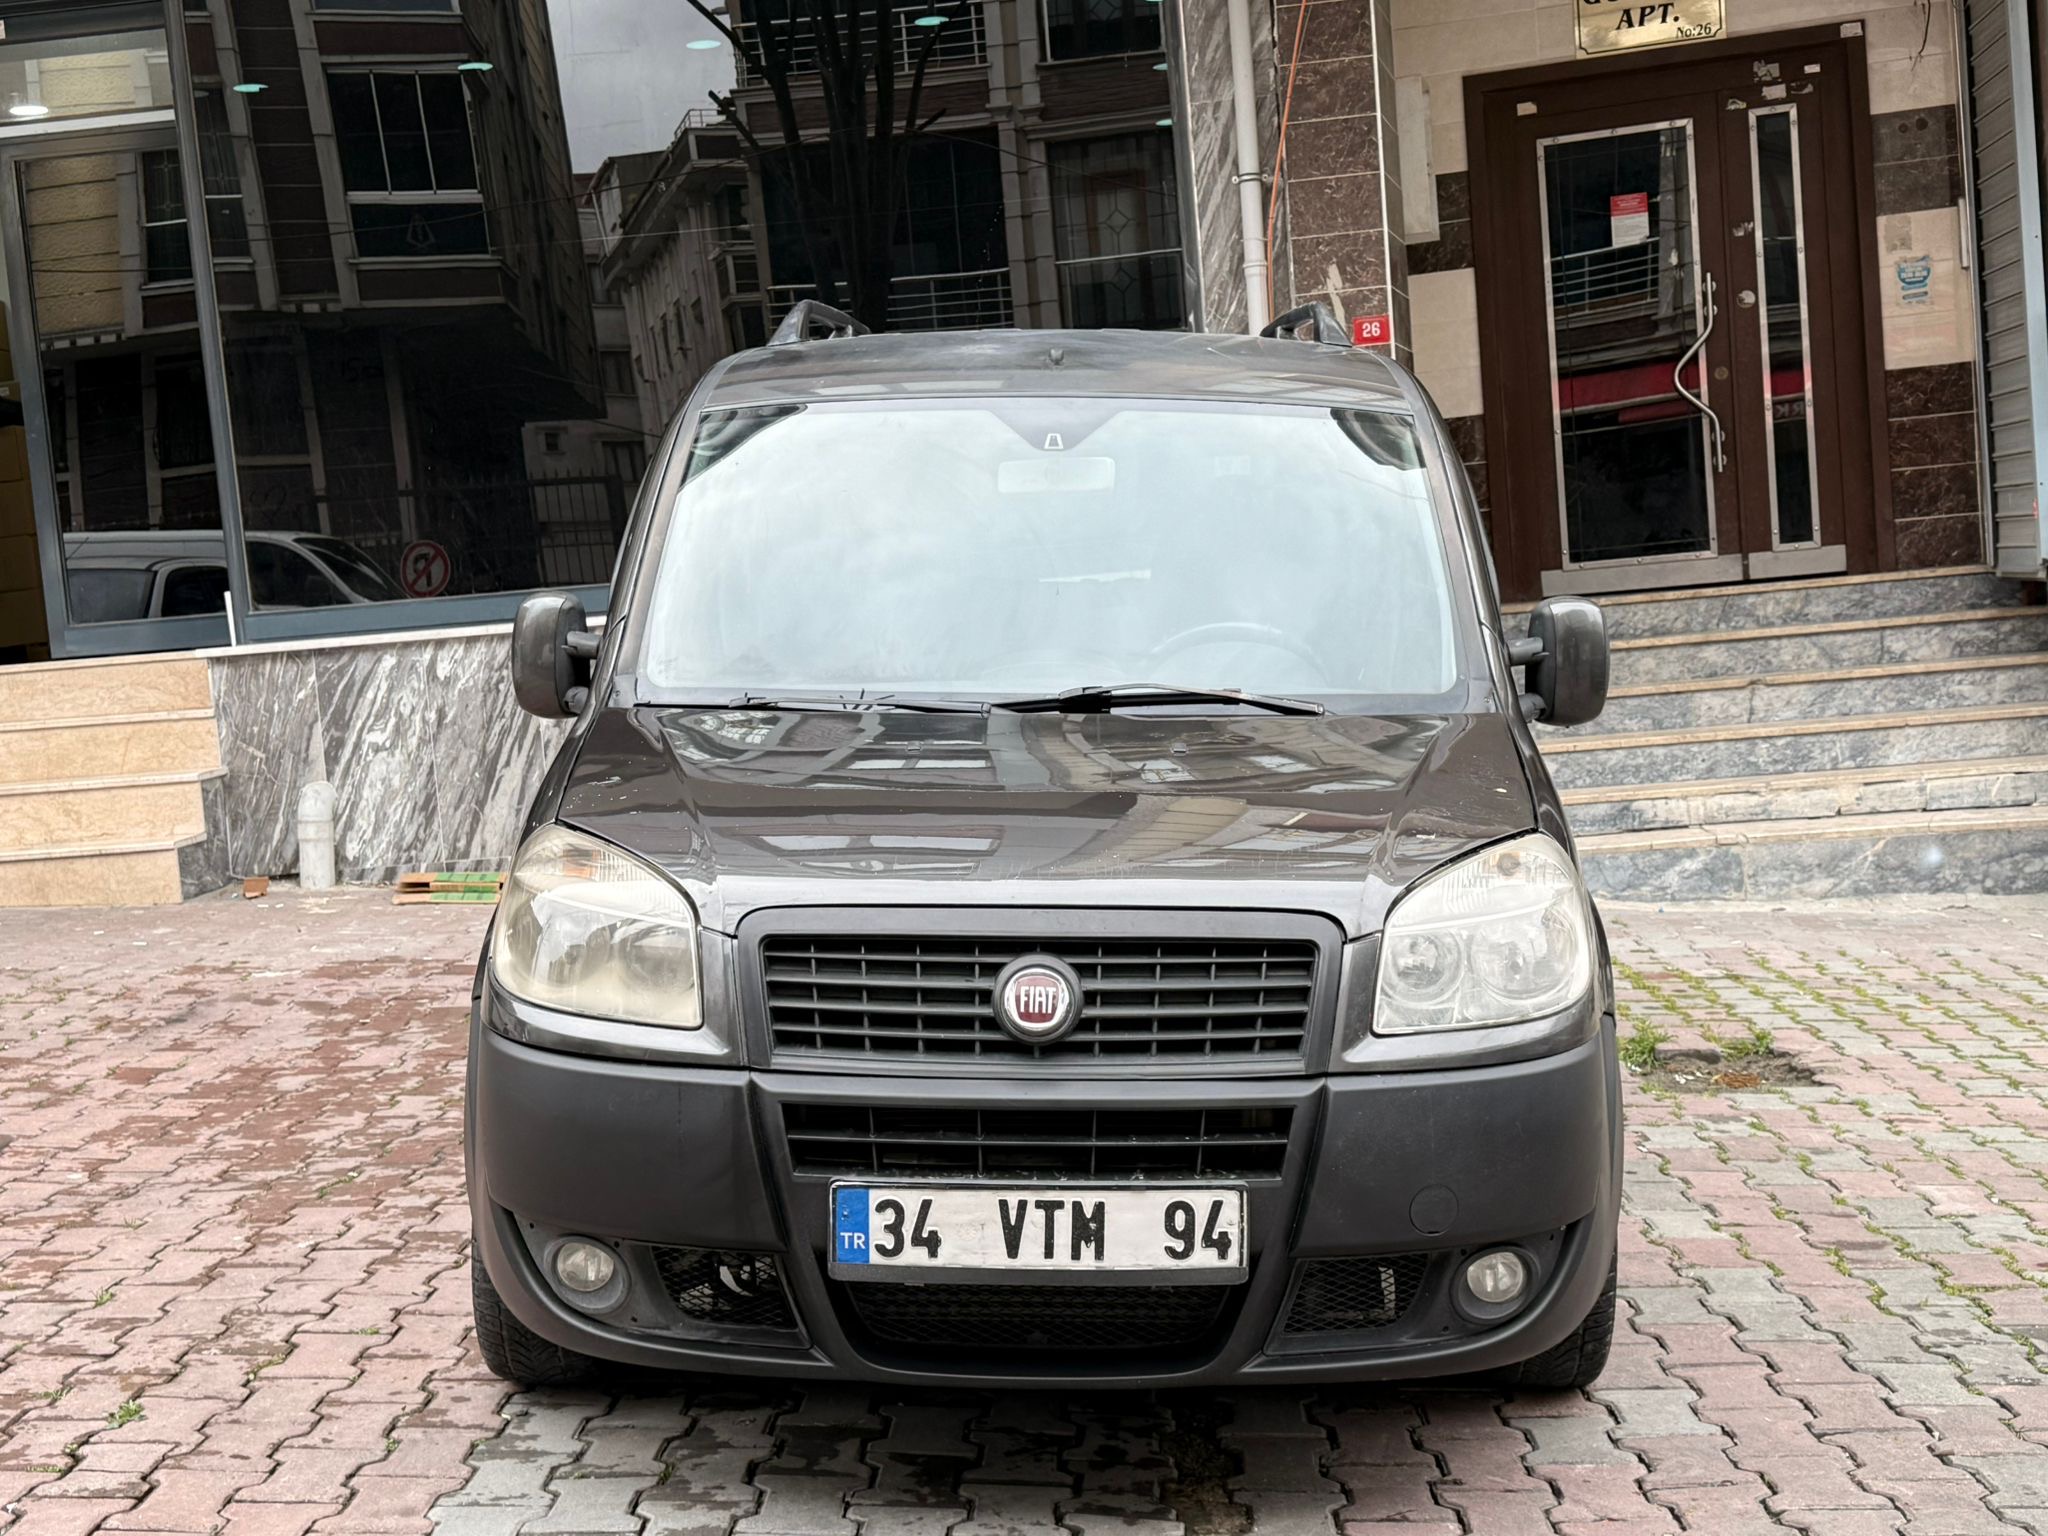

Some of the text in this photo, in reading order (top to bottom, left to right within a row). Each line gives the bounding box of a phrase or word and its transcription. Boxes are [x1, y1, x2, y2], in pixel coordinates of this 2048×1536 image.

[1615, 3, 1680, 30] APT.
[1676, 22, 1712, 39] No:26
[1362, 322, 1381, 338] 26
[1020, 985, 1056, 1014] FIAT
[840, 1198, 1233, 1261] TR 34 VTM 94
